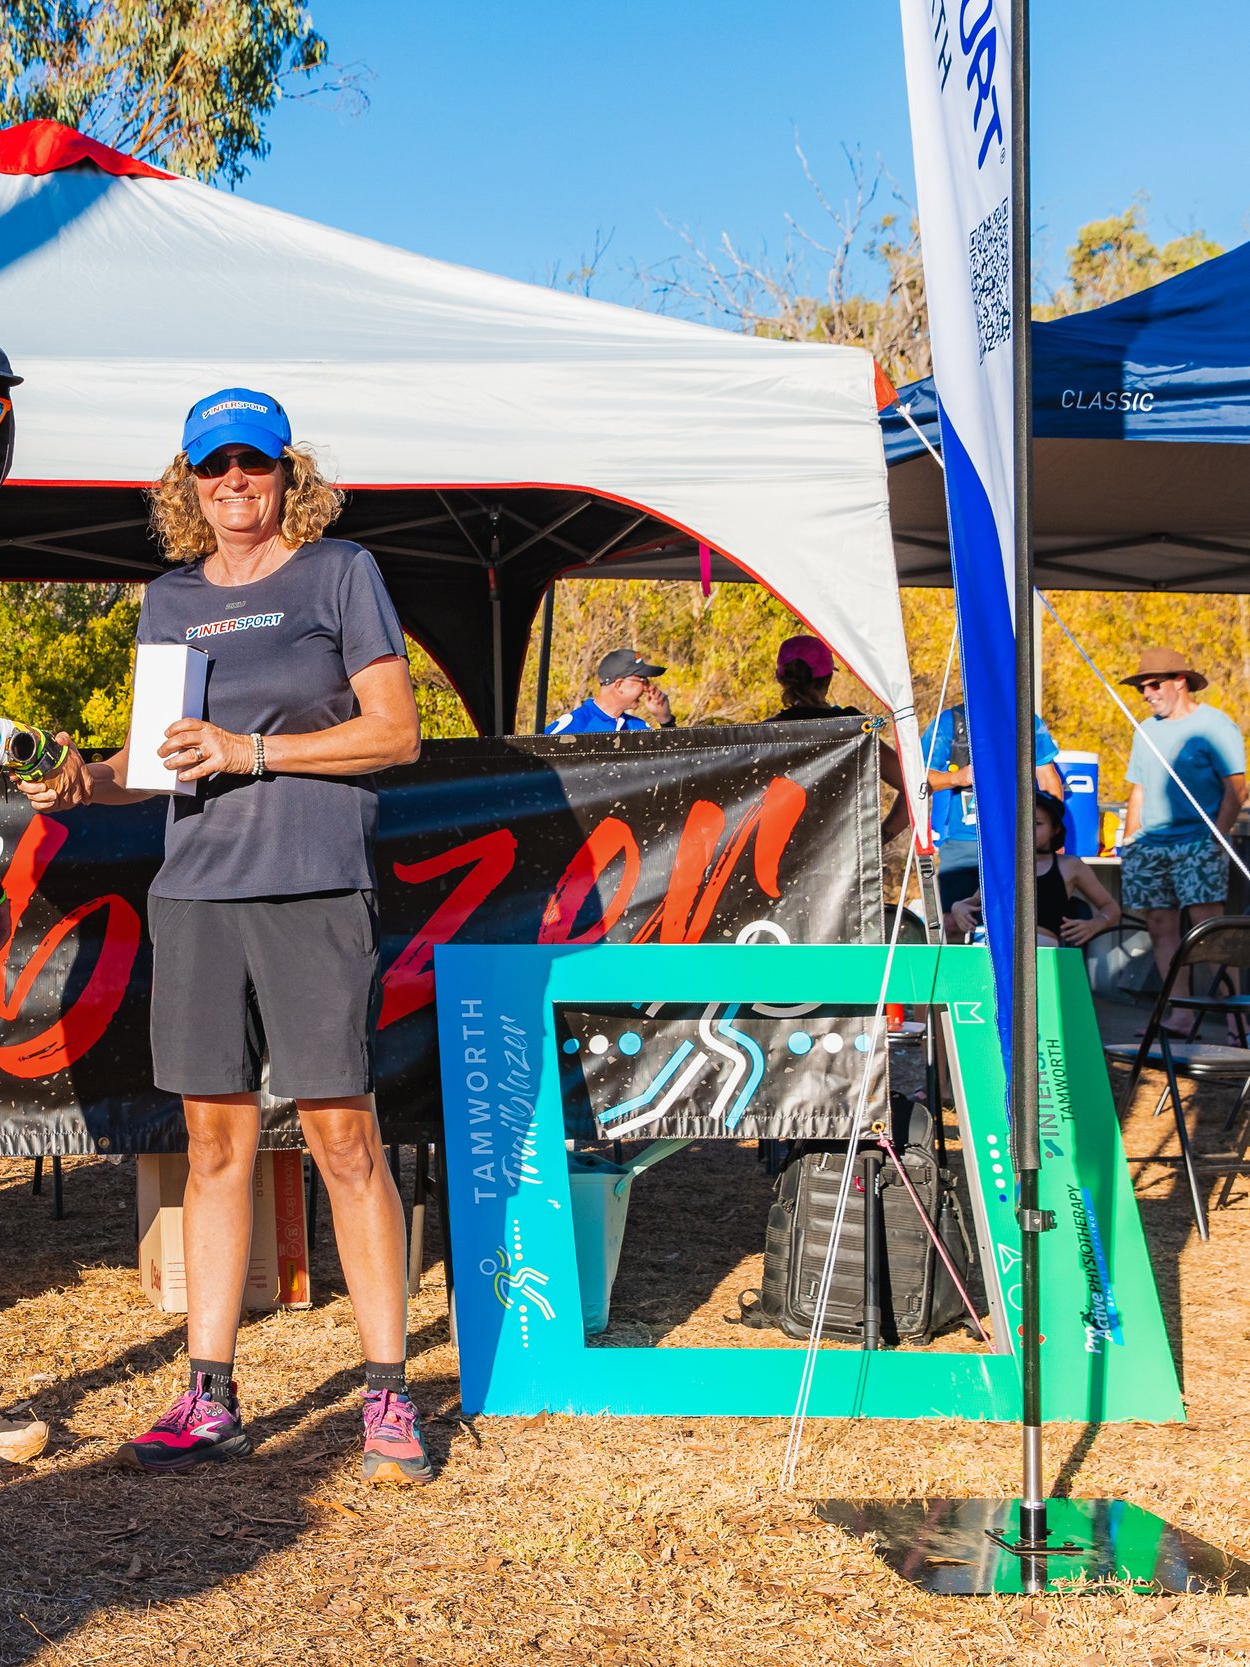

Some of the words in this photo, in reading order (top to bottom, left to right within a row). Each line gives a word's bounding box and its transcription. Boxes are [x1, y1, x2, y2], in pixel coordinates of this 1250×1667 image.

[209, 400, 269, 414] INTERSPORT
[1061, 389, 1155, 412] CLASSIC
[198, 613, 283, 637] INTERSPORT
[461, 1000, 497, 1205] TAMWORTH
[498, 1014, 544, 1189] Trailblazer
[1046, 1039, 1076, 1123] TAMWORTH
